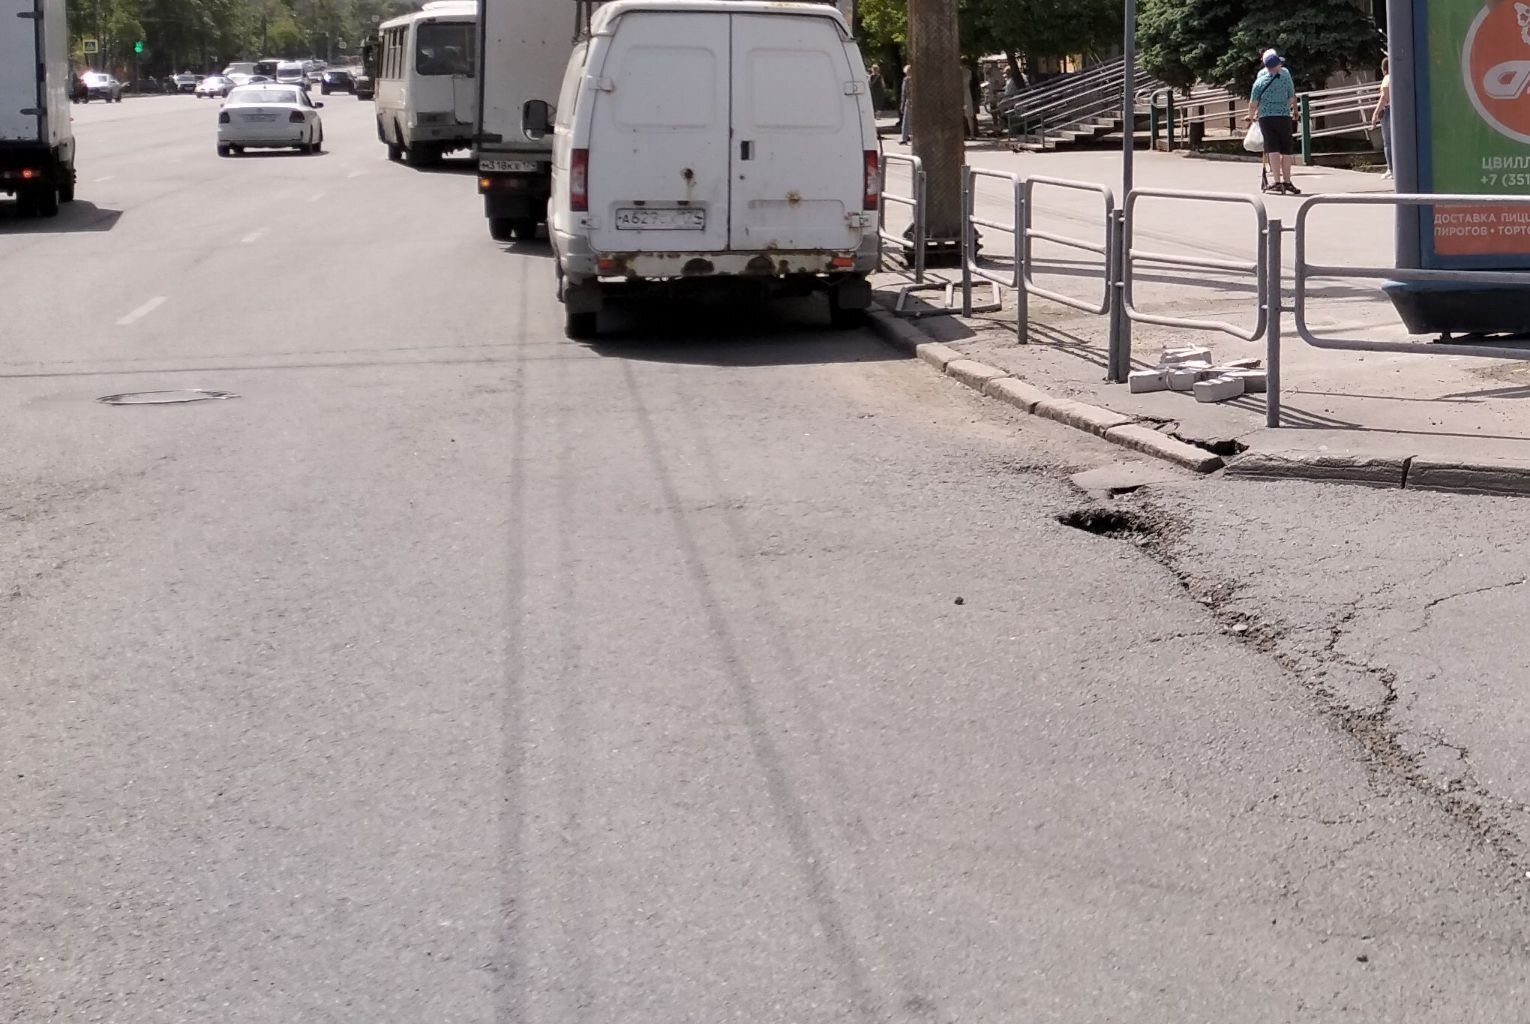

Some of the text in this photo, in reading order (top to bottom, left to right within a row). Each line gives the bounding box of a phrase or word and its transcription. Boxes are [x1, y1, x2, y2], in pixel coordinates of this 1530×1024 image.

[1480, 173, 1497, 185] +7
[1434, 213, 1496, 224] ДОСТАВКА
[1434, 226, 1487, 236] ПИРОГОВ
